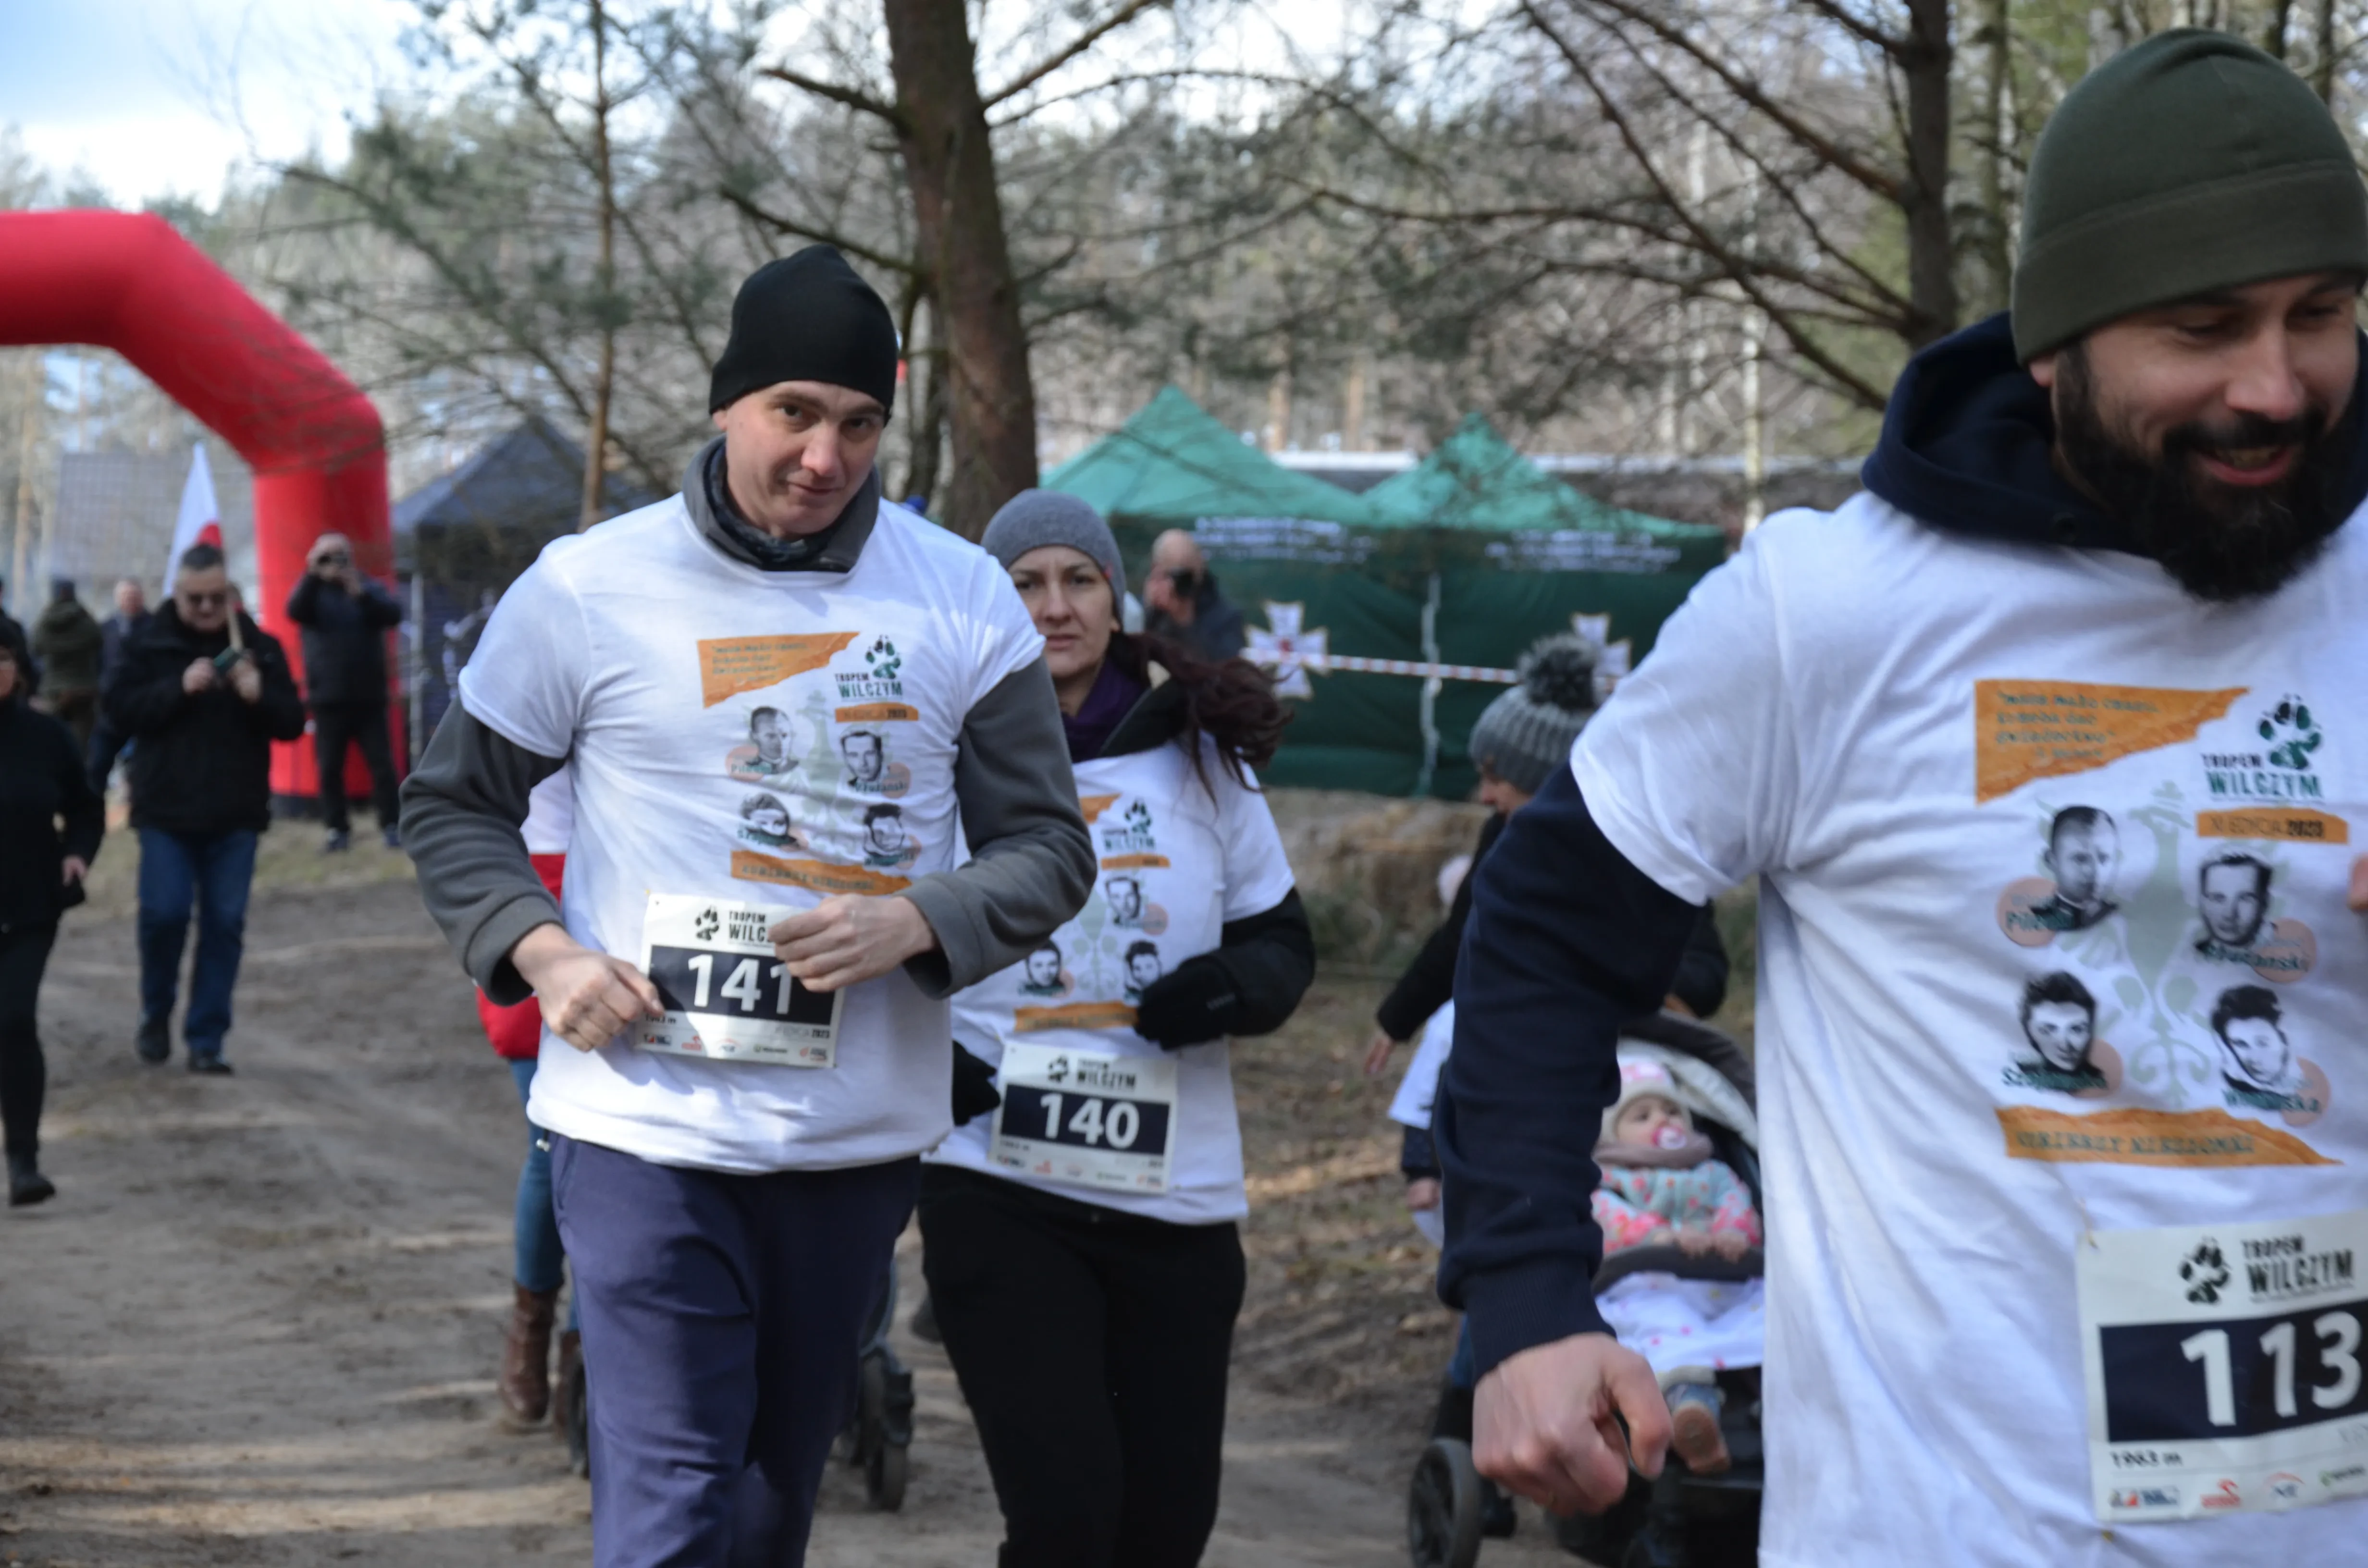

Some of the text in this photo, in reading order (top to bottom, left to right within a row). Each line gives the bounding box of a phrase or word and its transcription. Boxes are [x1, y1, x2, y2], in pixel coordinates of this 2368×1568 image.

[834, 672, 869, 682] TROPEM
[839, 682, 902, 698] WILCZYM
[2200, 753, 2261, 768] TROPEM
[2206, 771, 2326, 798] WILCZYM
[729, 910, 765, 923] TROPEM
[729, 923, 772, 943] WILC
[688, 954, 792, 1015] 141
[1040, 1093, 1140, 1150] 140
[2241, 1233, 2305, 1259] TROPEM
[2247, 1248, 2354, 1294] WILCZYM
[2180, 1311, 2361, 1427] 113
